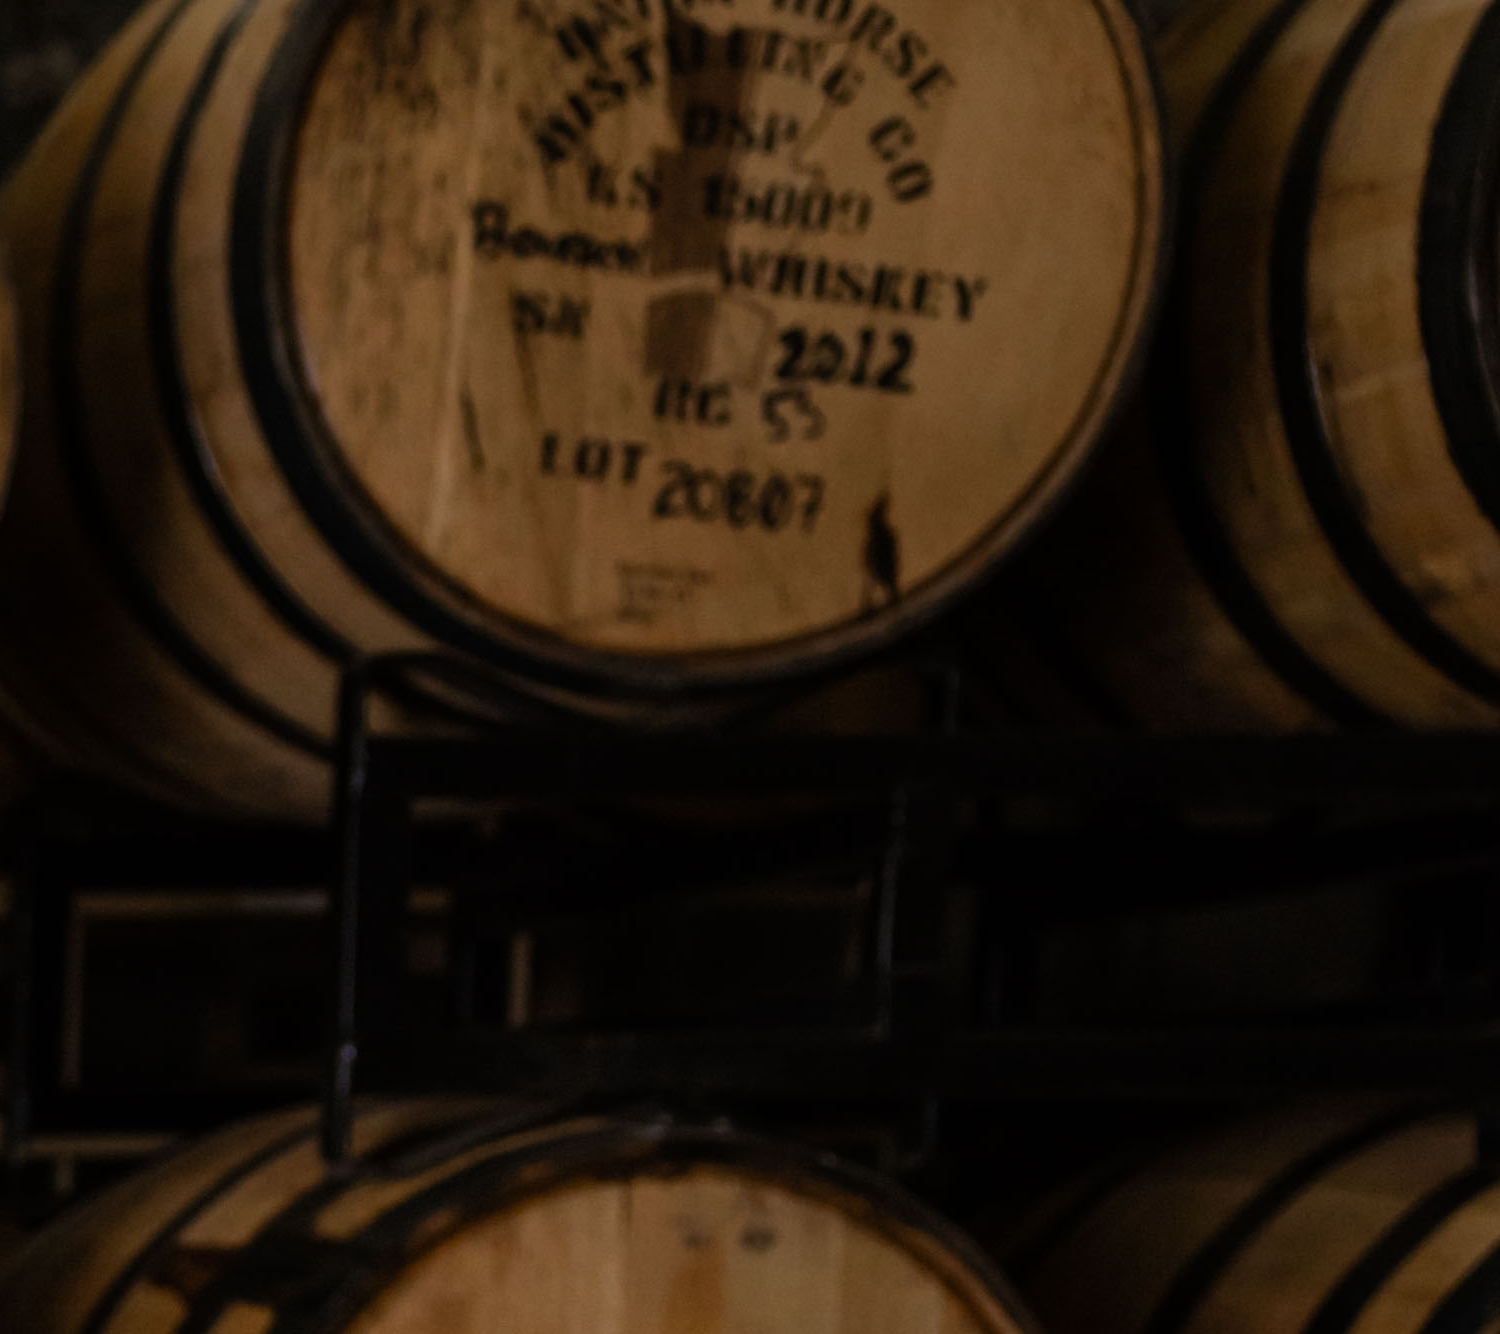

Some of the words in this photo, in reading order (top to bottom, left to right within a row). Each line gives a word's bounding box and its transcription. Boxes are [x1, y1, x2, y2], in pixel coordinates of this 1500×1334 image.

[866, 114, 937, 204] CO
[716, 245, 990, 324] WHISKEY
[772, 324, 919, 396] 2012
[539, 430, 651, 487] LOT
